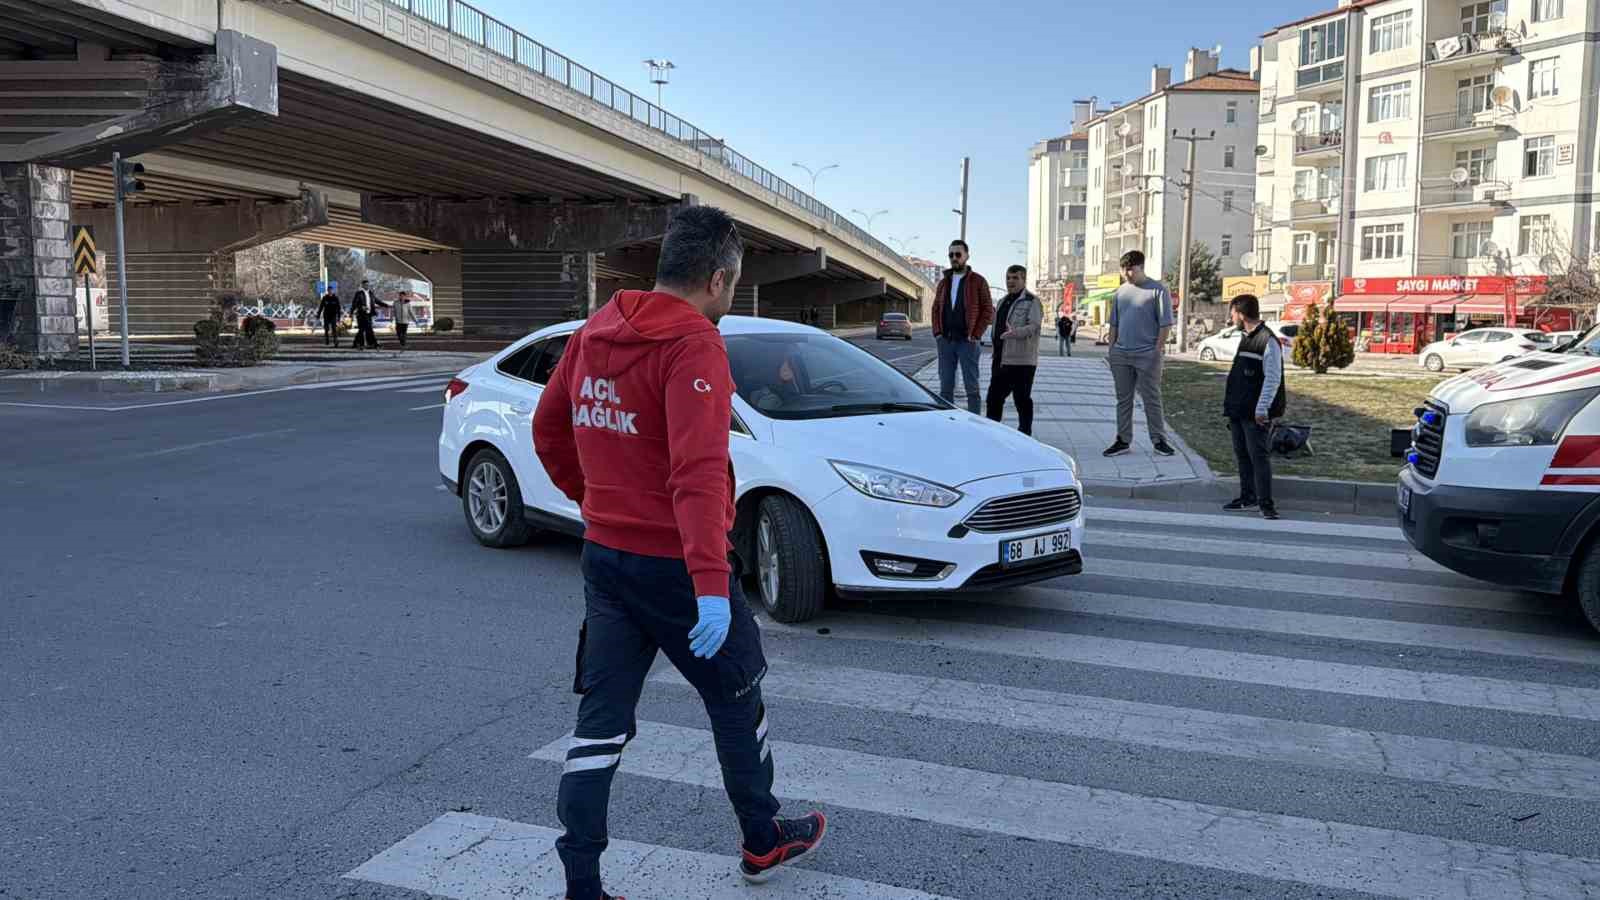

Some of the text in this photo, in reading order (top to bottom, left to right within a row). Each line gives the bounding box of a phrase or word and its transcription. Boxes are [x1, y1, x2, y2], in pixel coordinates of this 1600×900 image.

[1396, 278, 1479, 291] SAYGI MARKET
[1010, 533, 1069, 560] 68 AJ 992
